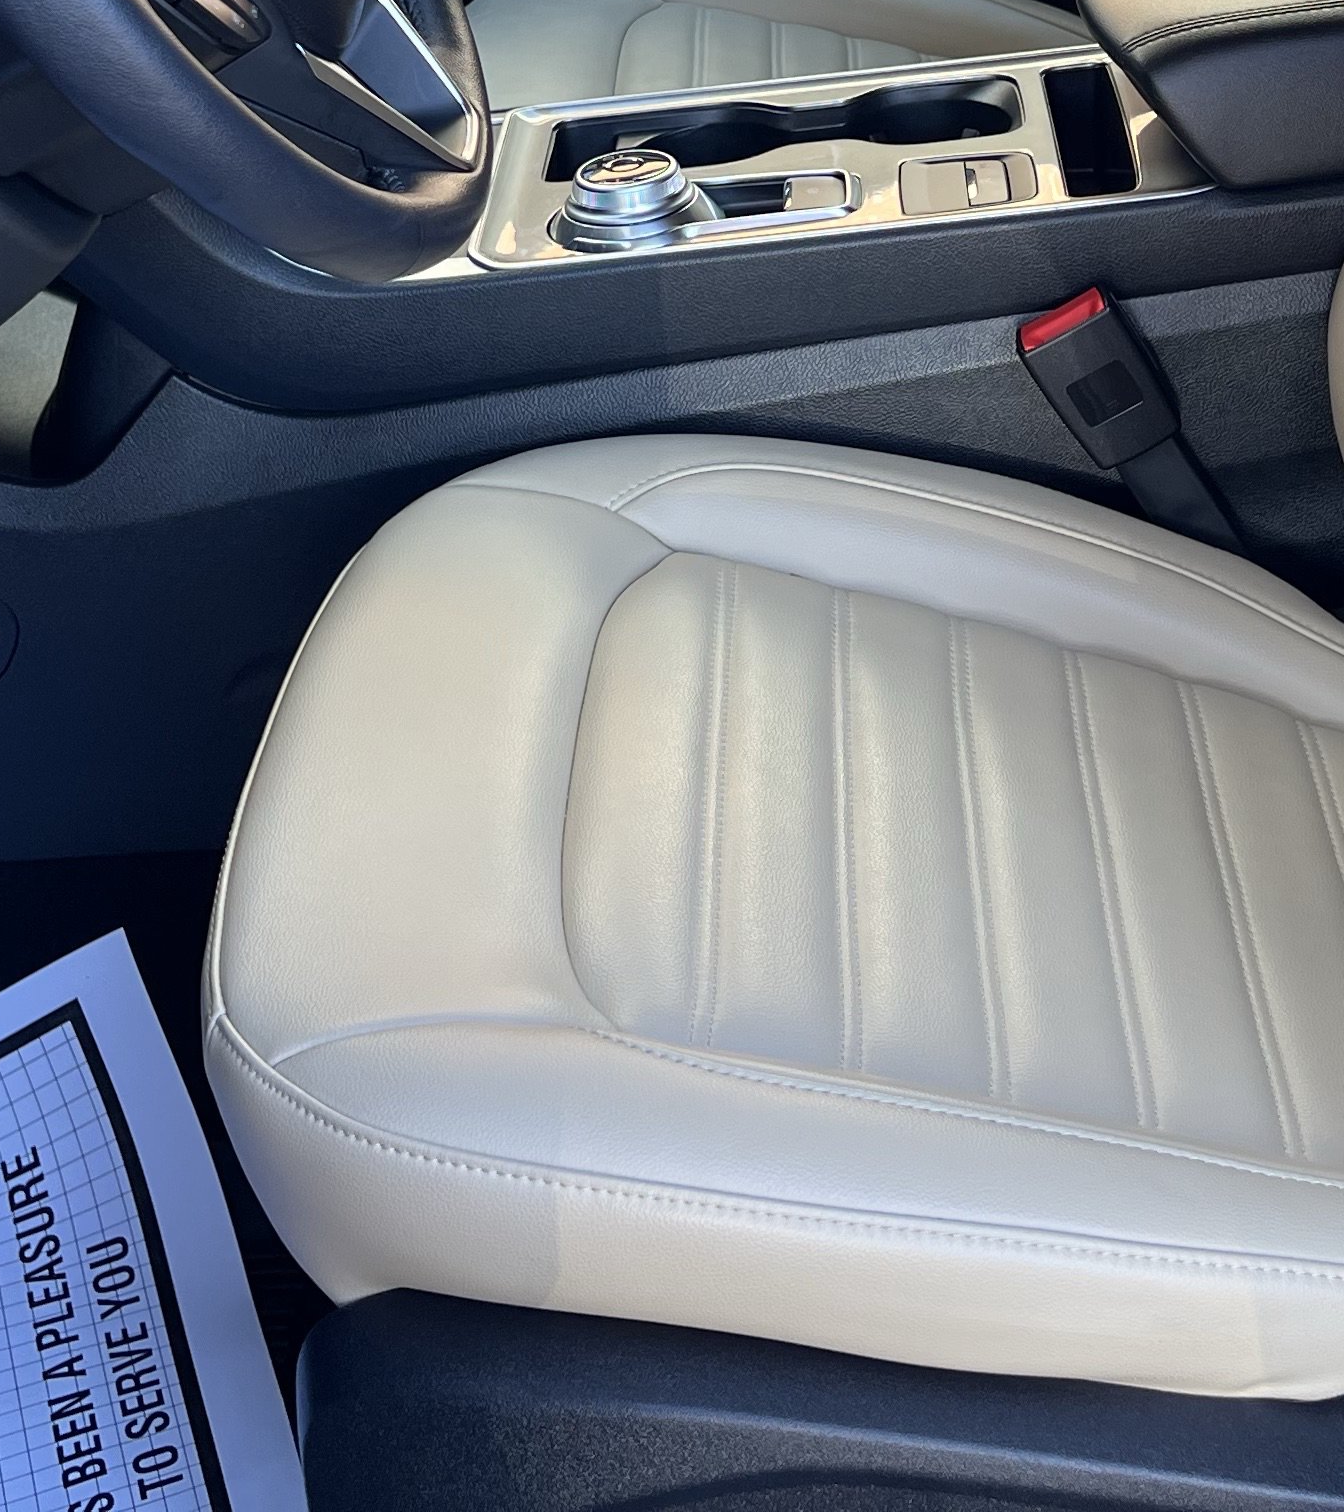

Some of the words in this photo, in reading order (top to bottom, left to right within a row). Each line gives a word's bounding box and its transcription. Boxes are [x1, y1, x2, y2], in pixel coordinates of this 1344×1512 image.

[0, 1144, 80, 1353] PLEASURE
[85, 1236, 141, 1320] YOU
[42, 1353, 88, 1381] A
[104, 1321, 171, 1441] SERVE
[46, 1388, 108, 1490] BEEN
[132, 1444, 184, 1501] TO
